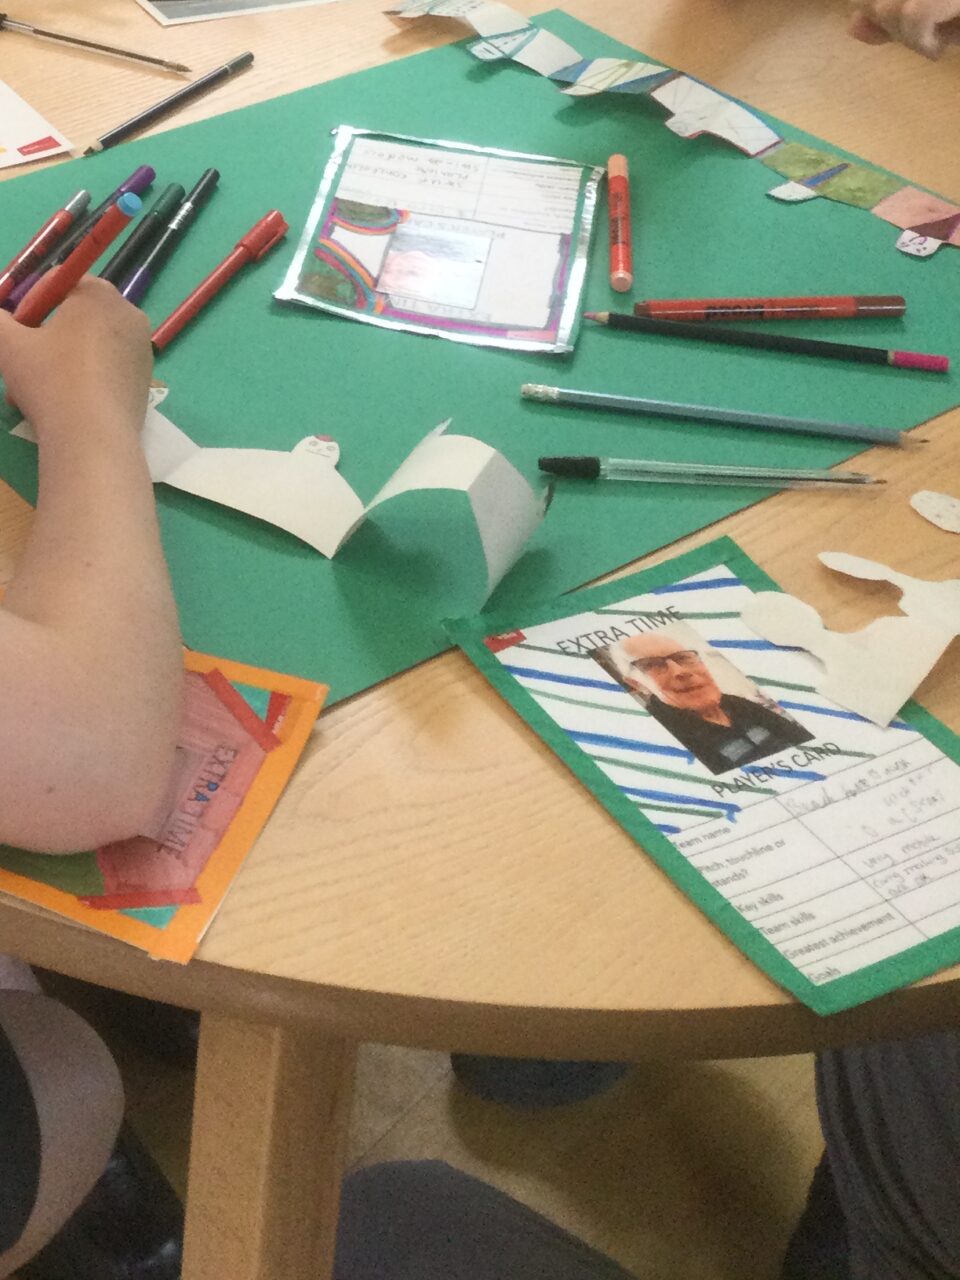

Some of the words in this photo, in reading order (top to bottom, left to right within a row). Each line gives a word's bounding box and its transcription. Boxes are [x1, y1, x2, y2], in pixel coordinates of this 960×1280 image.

[556, 625, 630, 656] EXTRA
[625, 605, 683, 633] TIME
[187, 742, 238, 803] EXTRA
[711, 760, 794, 799] PLAYER'S
[791, 742, 841, 768] CARD
[155, 801, 205, 860] TIME
[758, 891, 785, 907] skills
[790, 911, 817, 926] skills
[783, 938, 830, 960] Greatest
[828, 911, 897, 944] achievement
